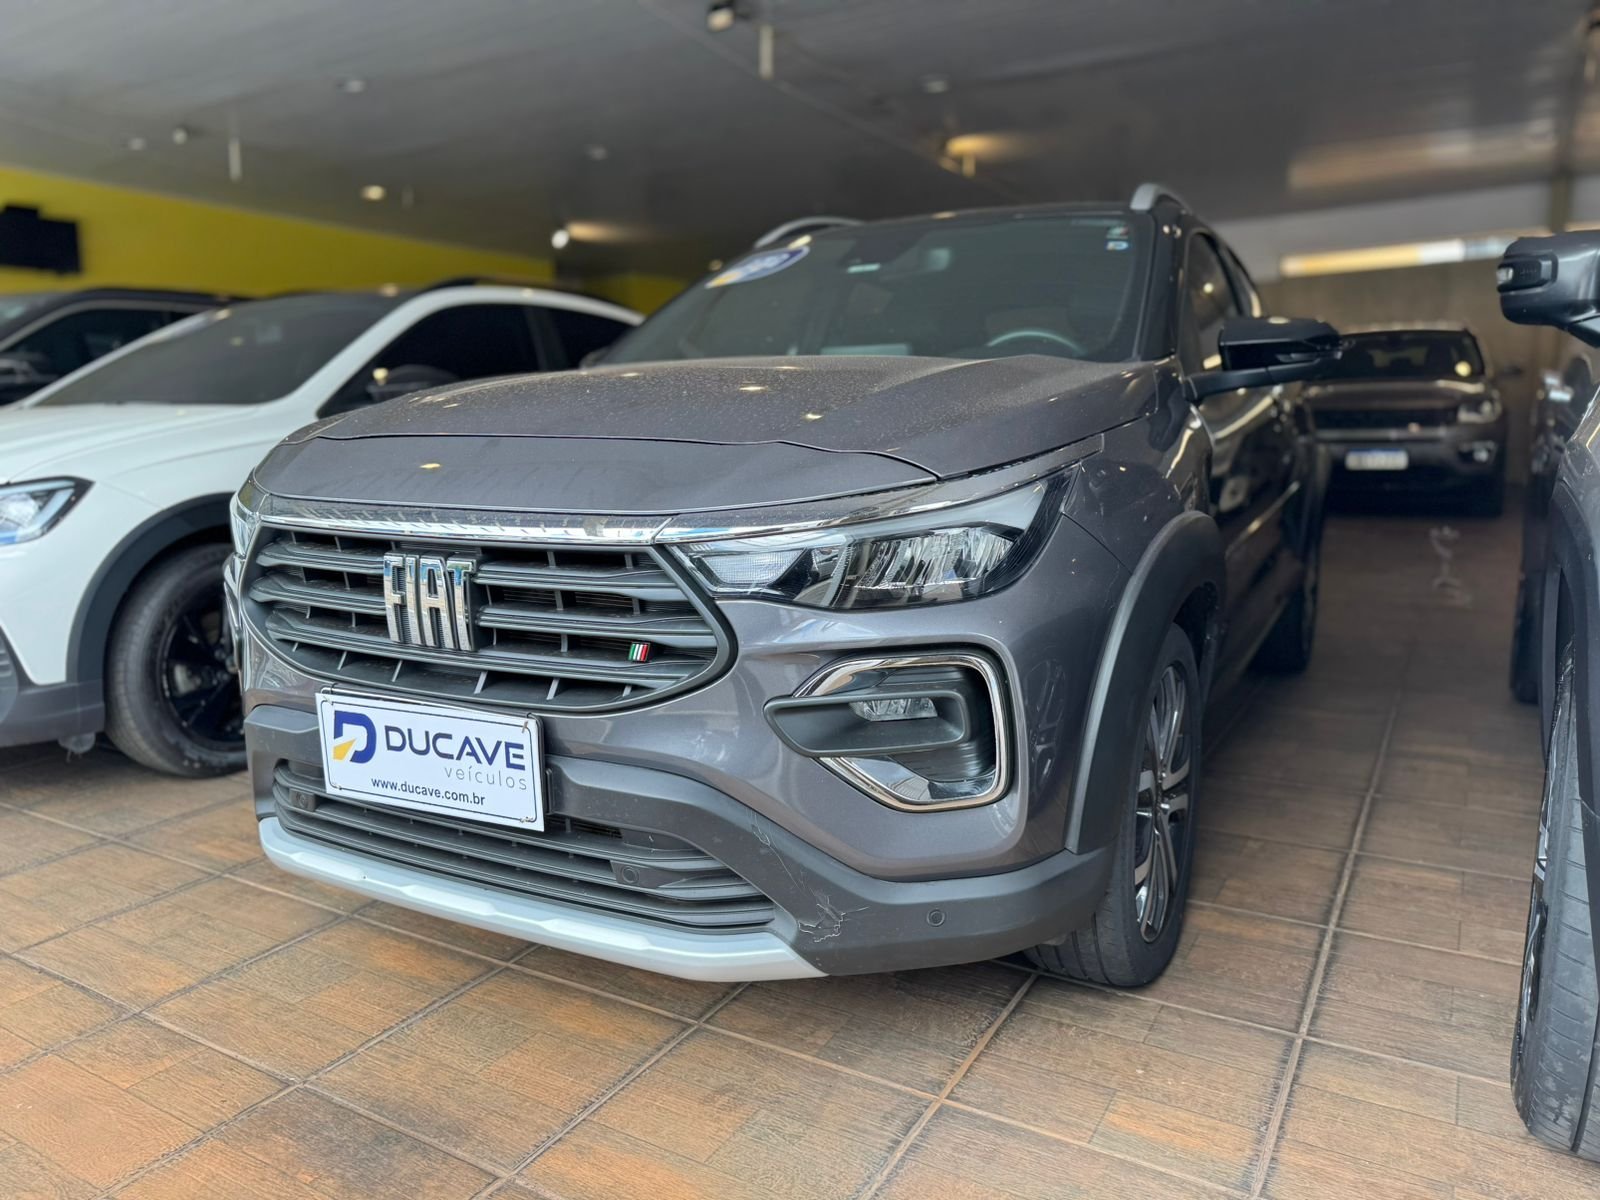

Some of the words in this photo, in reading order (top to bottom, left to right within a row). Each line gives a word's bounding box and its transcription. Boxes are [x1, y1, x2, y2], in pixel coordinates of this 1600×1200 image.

[383, 554, 475, 651] FIAT
[384, 725, 526, 771] DUCAVE
[371, 777, 486, 806] www.ducave.com.br
[444, 766, 527, 791] veículos
